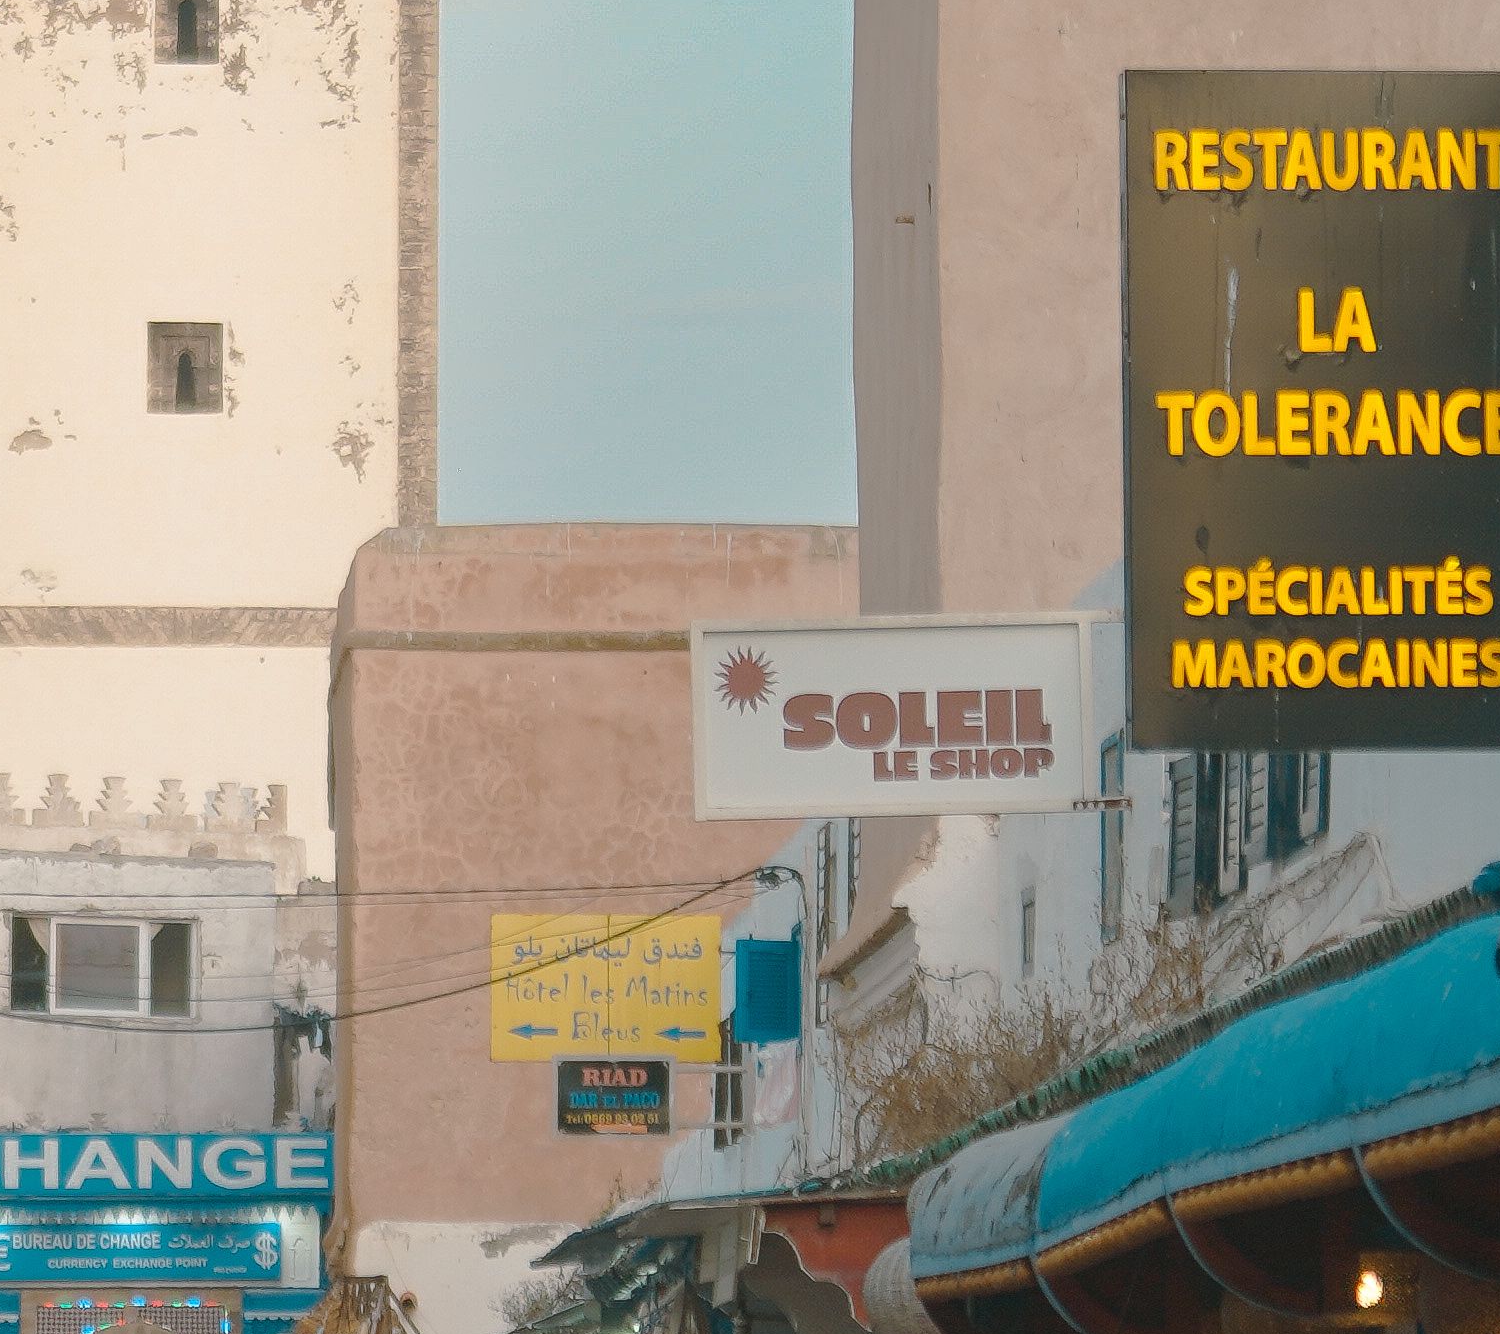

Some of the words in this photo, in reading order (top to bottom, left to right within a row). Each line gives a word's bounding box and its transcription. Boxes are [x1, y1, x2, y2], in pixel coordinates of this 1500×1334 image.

[1296, 286, 1377, 354] LA
[1183, 556, 1495, 618] SPÉCIALITÉS
[782, 688, 1053, 751] SOLEIL
[873, 749, 919, 782] LE
[929, 747, 1055, 780] SHOP
[506, 971, 570, 1003] Hôtel
[582, 973, 616, 1005] les
[582, 1068, 649, 1087] RIAD
[11, 1232, 74, 1250] BUREAU
[76, 1232, 98, 1250] DE
[99, 1232, 162, 1250] CHANGE
[46, 1257, 108, 1270] CURRENCY
[112, 1257, 173, 1269] EXCHANGE
[175, 1257, 209, 1269] POINT
